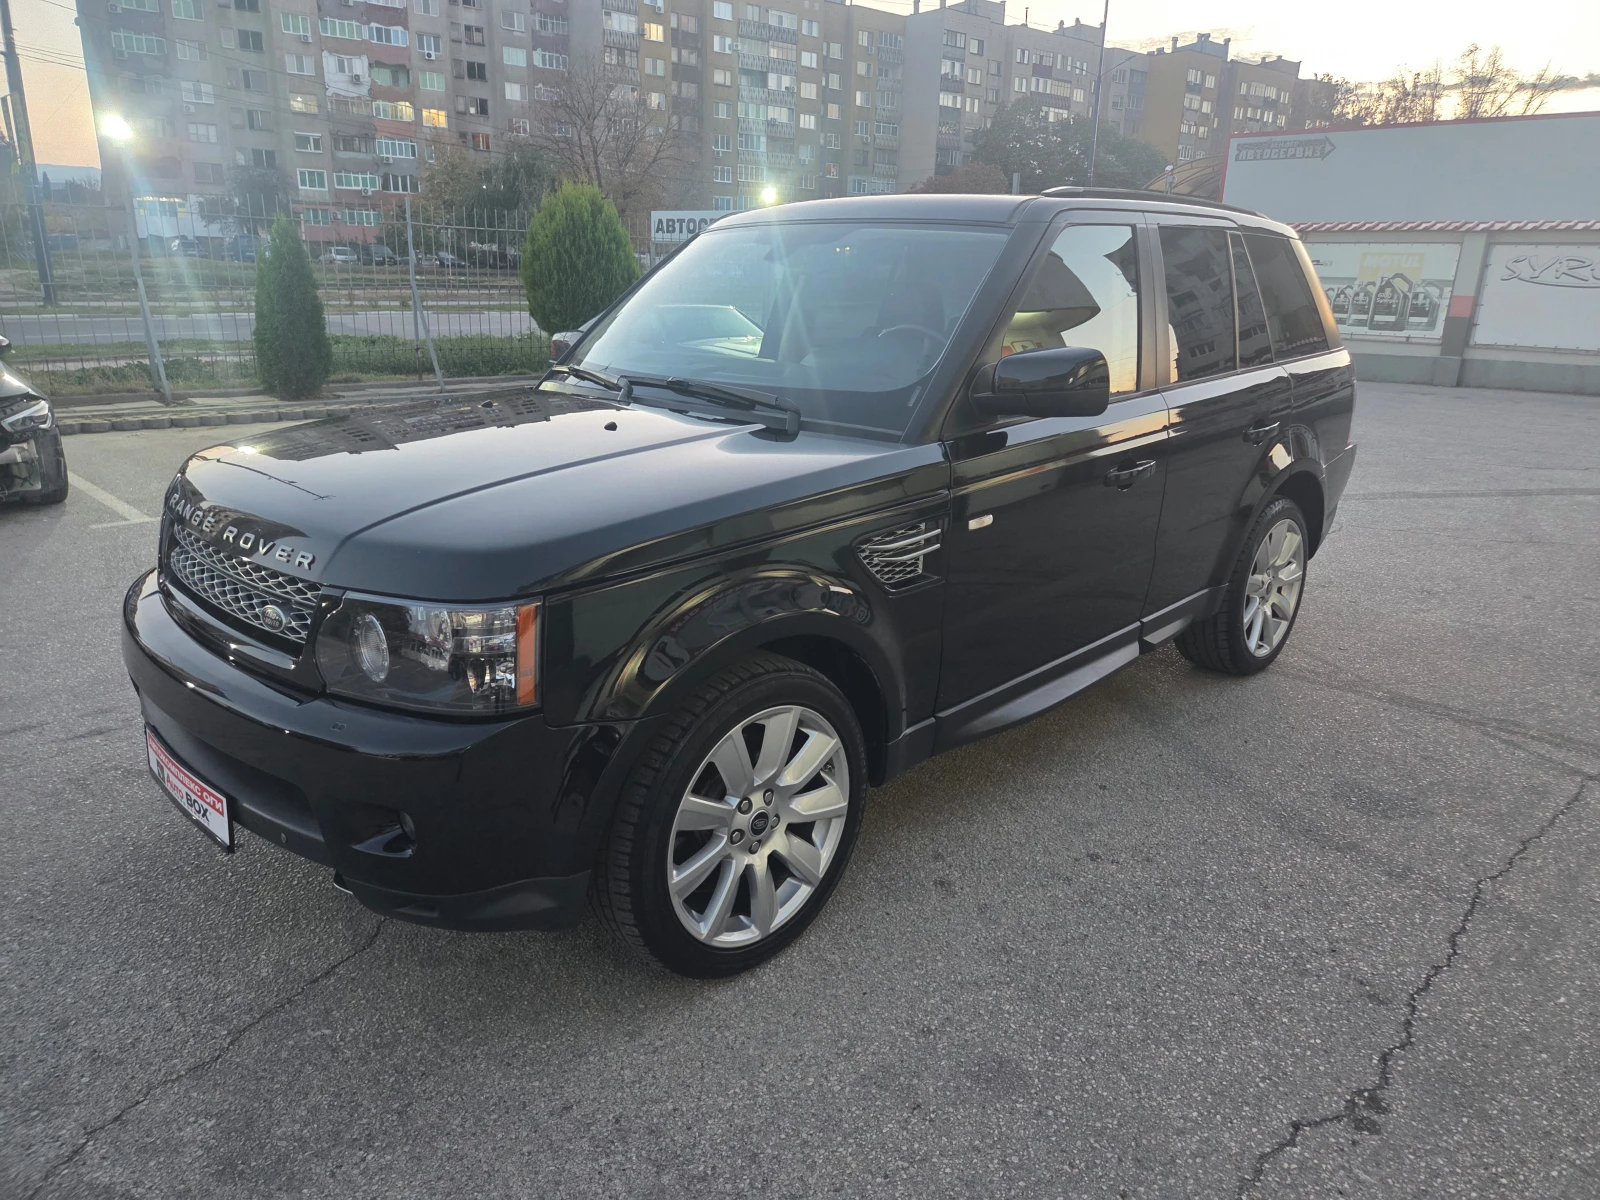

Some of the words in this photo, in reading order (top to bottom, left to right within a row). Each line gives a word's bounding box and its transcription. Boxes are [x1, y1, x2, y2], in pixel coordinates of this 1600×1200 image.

[1238, 145, 1321, 160] АВТОСЕРВИЗ
[1363, 254, 1420, 268] MOTUL
[169, 493, 216, 533] RANGE
[222, 525, 316, 571] ROVER
[185, 790, 210, 822] BOX
[202, 792, 224, 814] ОГИ
